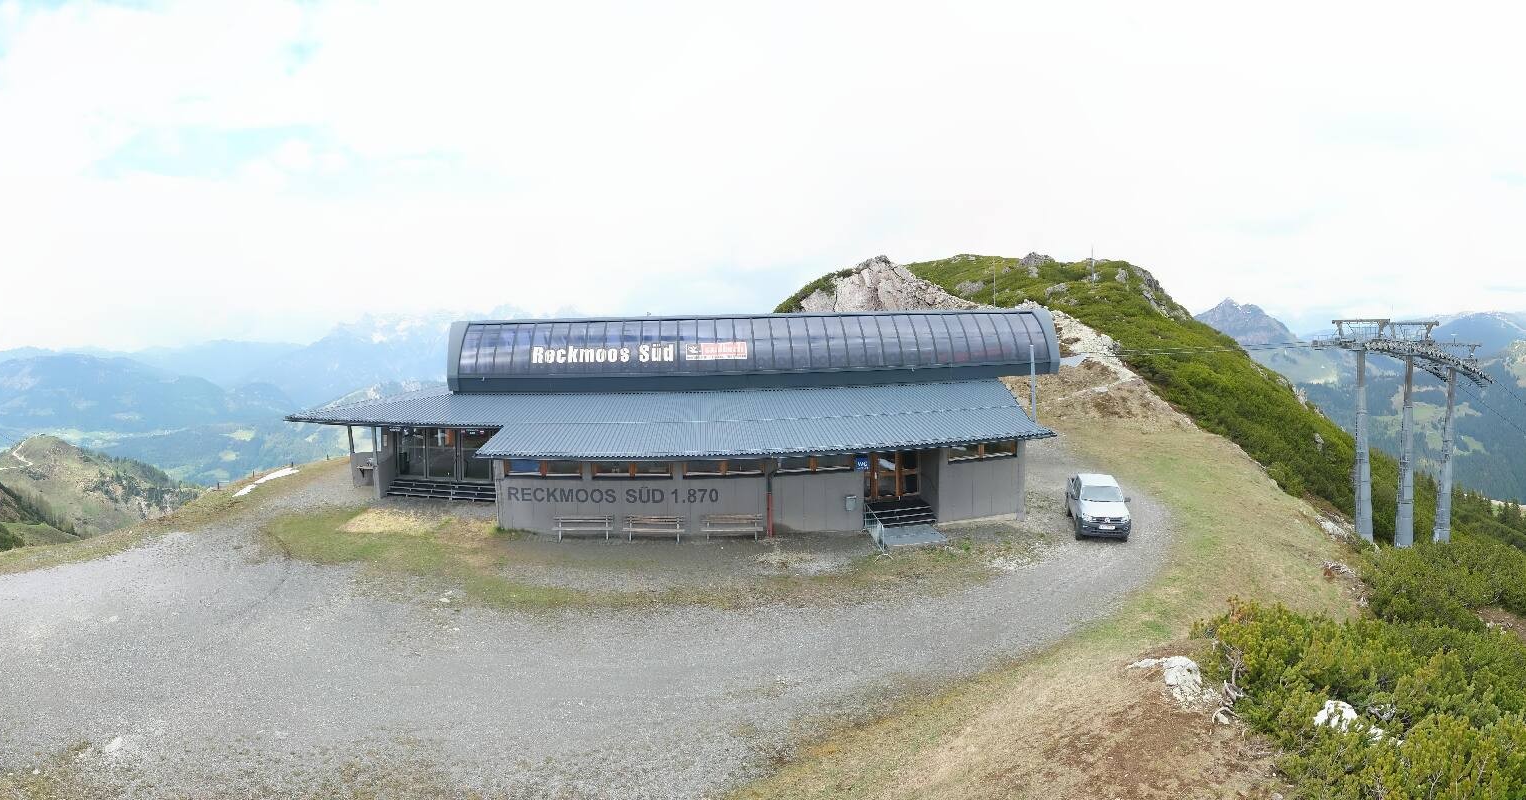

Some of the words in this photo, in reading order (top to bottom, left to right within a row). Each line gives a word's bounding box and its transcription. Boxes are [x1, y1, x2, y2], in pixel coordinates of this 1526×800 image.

[639, 344, 674, 362] Süd
[507, 487, 616, 504] RECKMOOS
[625, 486, 665, 504] SÜD
[671, 488, 720, 504] 1.870
